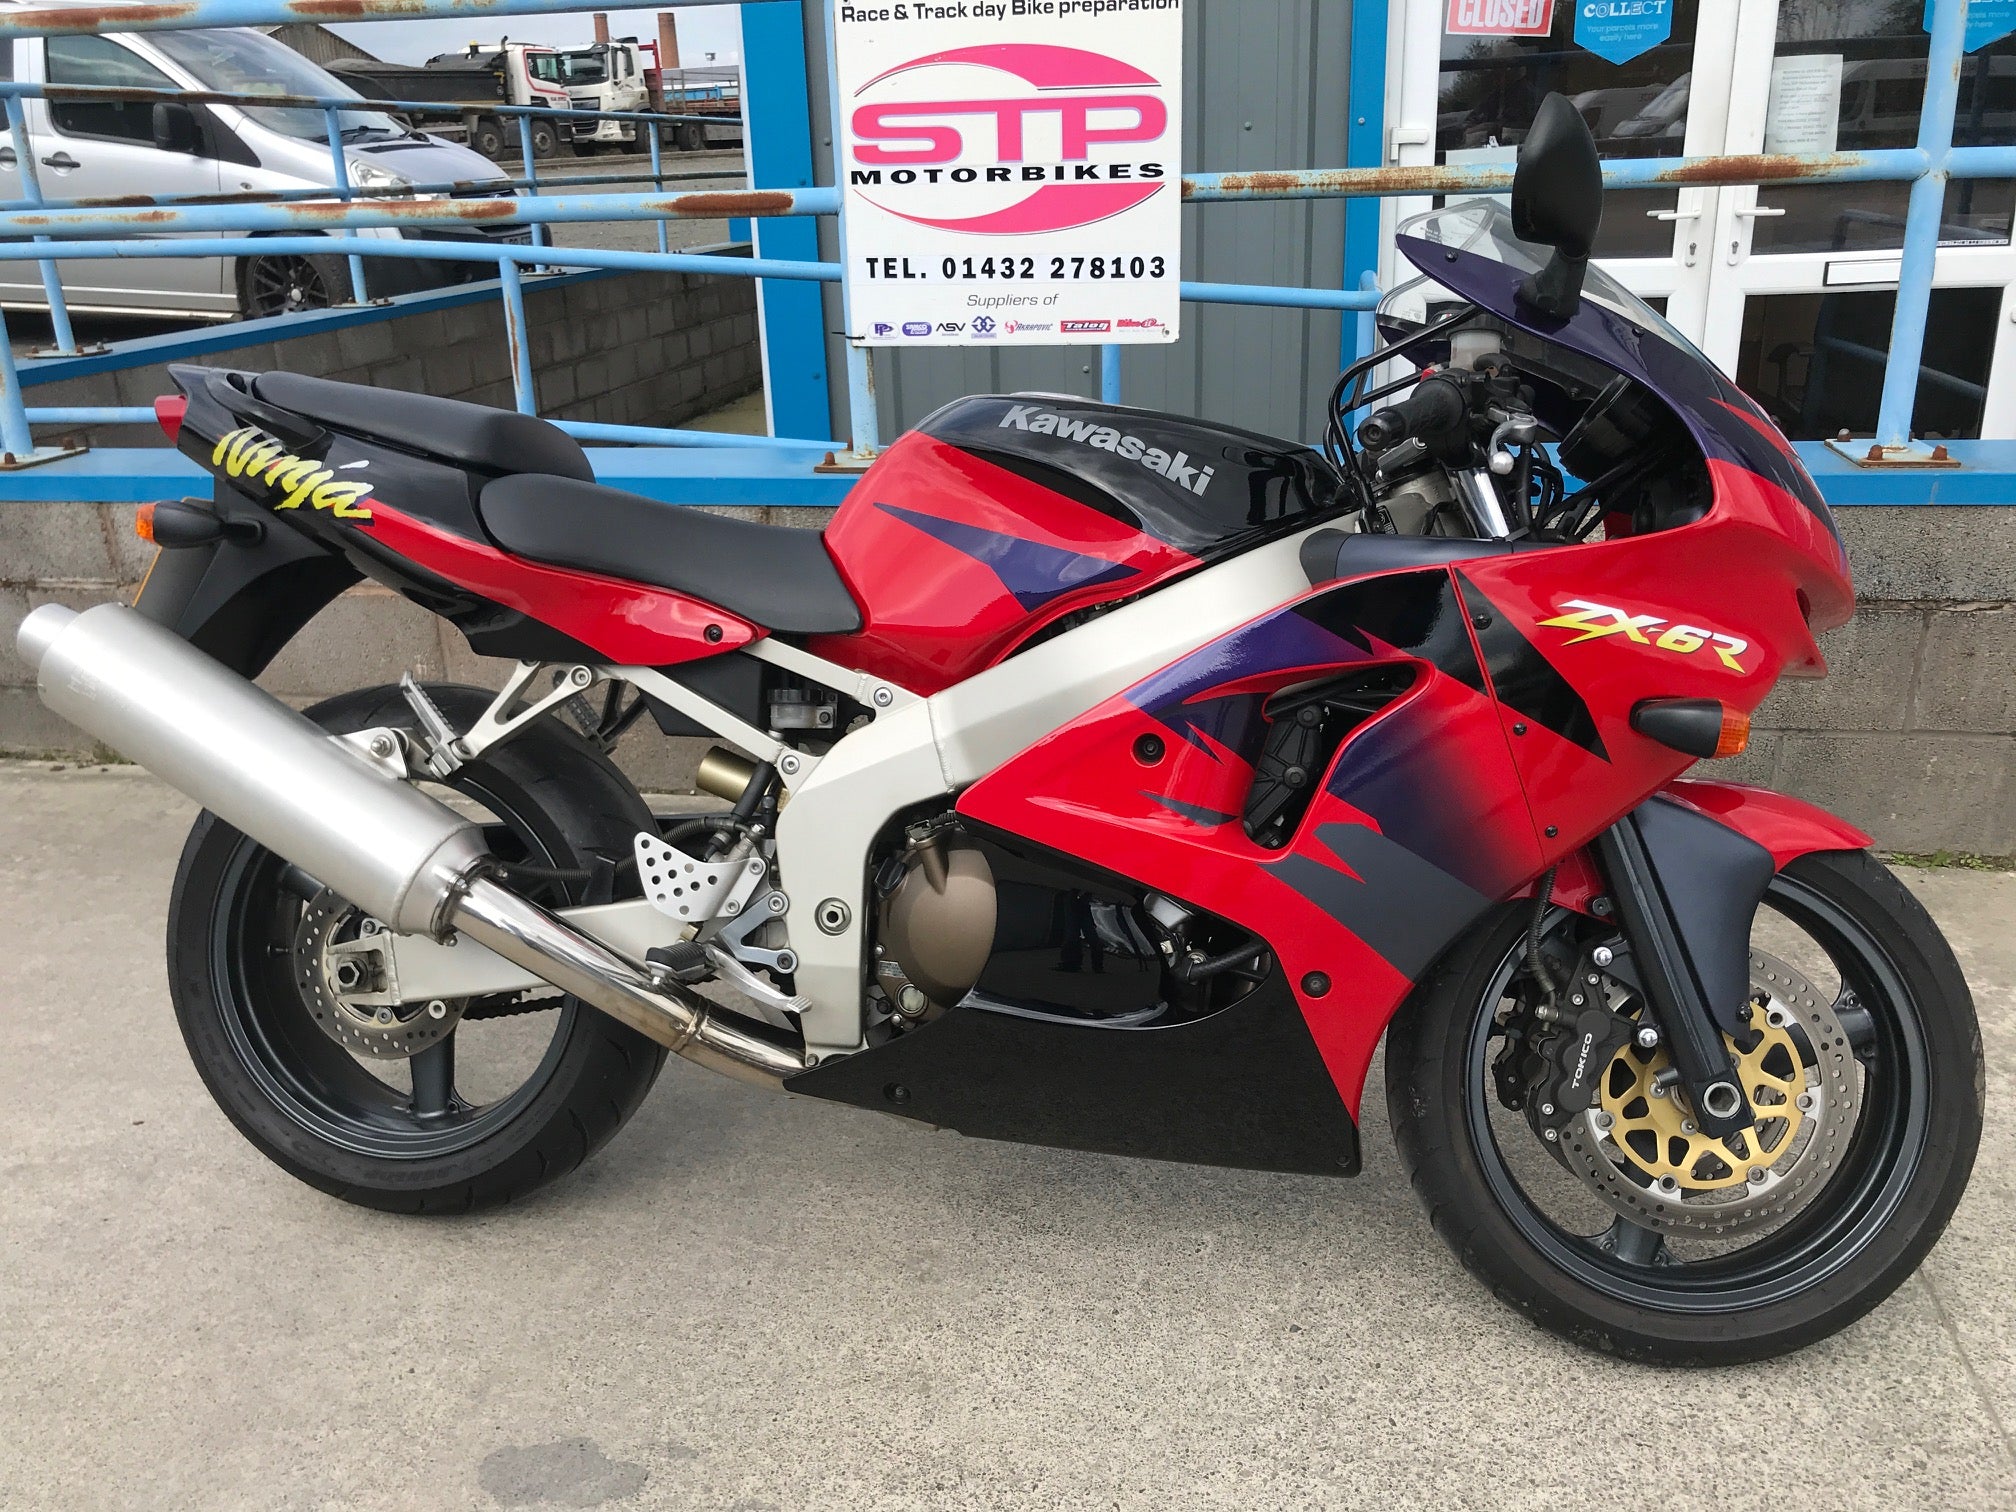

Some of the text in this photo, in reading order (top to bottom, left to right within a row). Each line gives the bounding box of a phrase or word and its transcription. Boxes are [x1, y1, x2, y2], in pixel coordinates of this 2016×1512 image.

[842, 0, 1177, 23] Race & Track day Bike preparation
[1458, 0, 1545, 29] CLOSED
[1584, 0, 1667, 18] COLLECT
[1587, 25, 1604, 33] Your
[1606, 24, 1635, 33] parcels
[1599, 34, 1622, 42] easily
[852, 95, 1167, 165] STP
[851, 163, 1165, 185] MOTORBIKES
[866, 256, 1165, 279] TEL. 01432 278103
[966, 293, 1060, 310] Suppliers of
[936, 322, 966, 332] ASV
[999, 405, 1215, 497] Kawasaki
[212, 425, 374, 519] Ninja
[1536, 599, 1748, 674] ZX-6R
[1571, 1033, 1593, 1089] TOKICO
